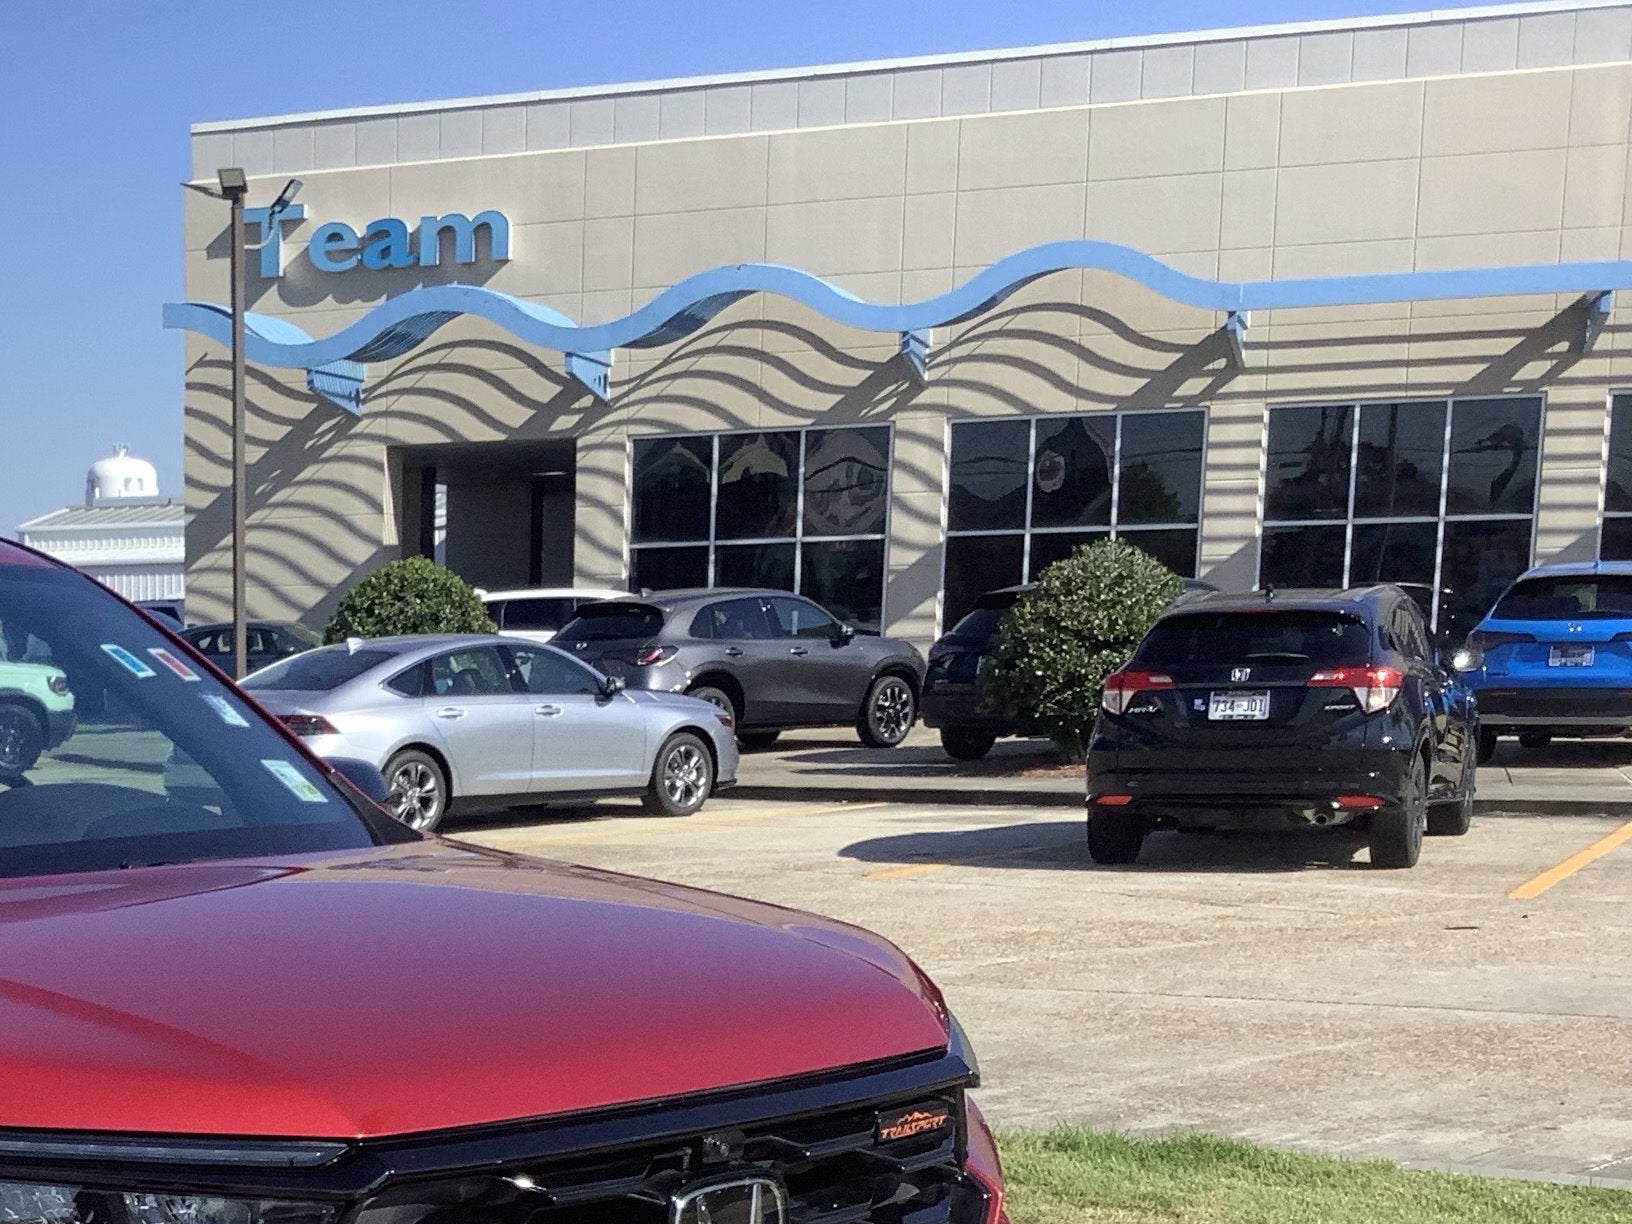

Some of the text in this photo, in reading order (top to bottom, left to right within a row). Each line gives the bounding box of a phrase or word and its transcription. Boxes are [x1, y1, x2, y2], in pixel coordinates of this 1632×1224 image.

[241, 204, 512, 279] Team
[1213, 700, 1235, 713] 734
[880, 1114, 948, 1140] TRAILSPORT
